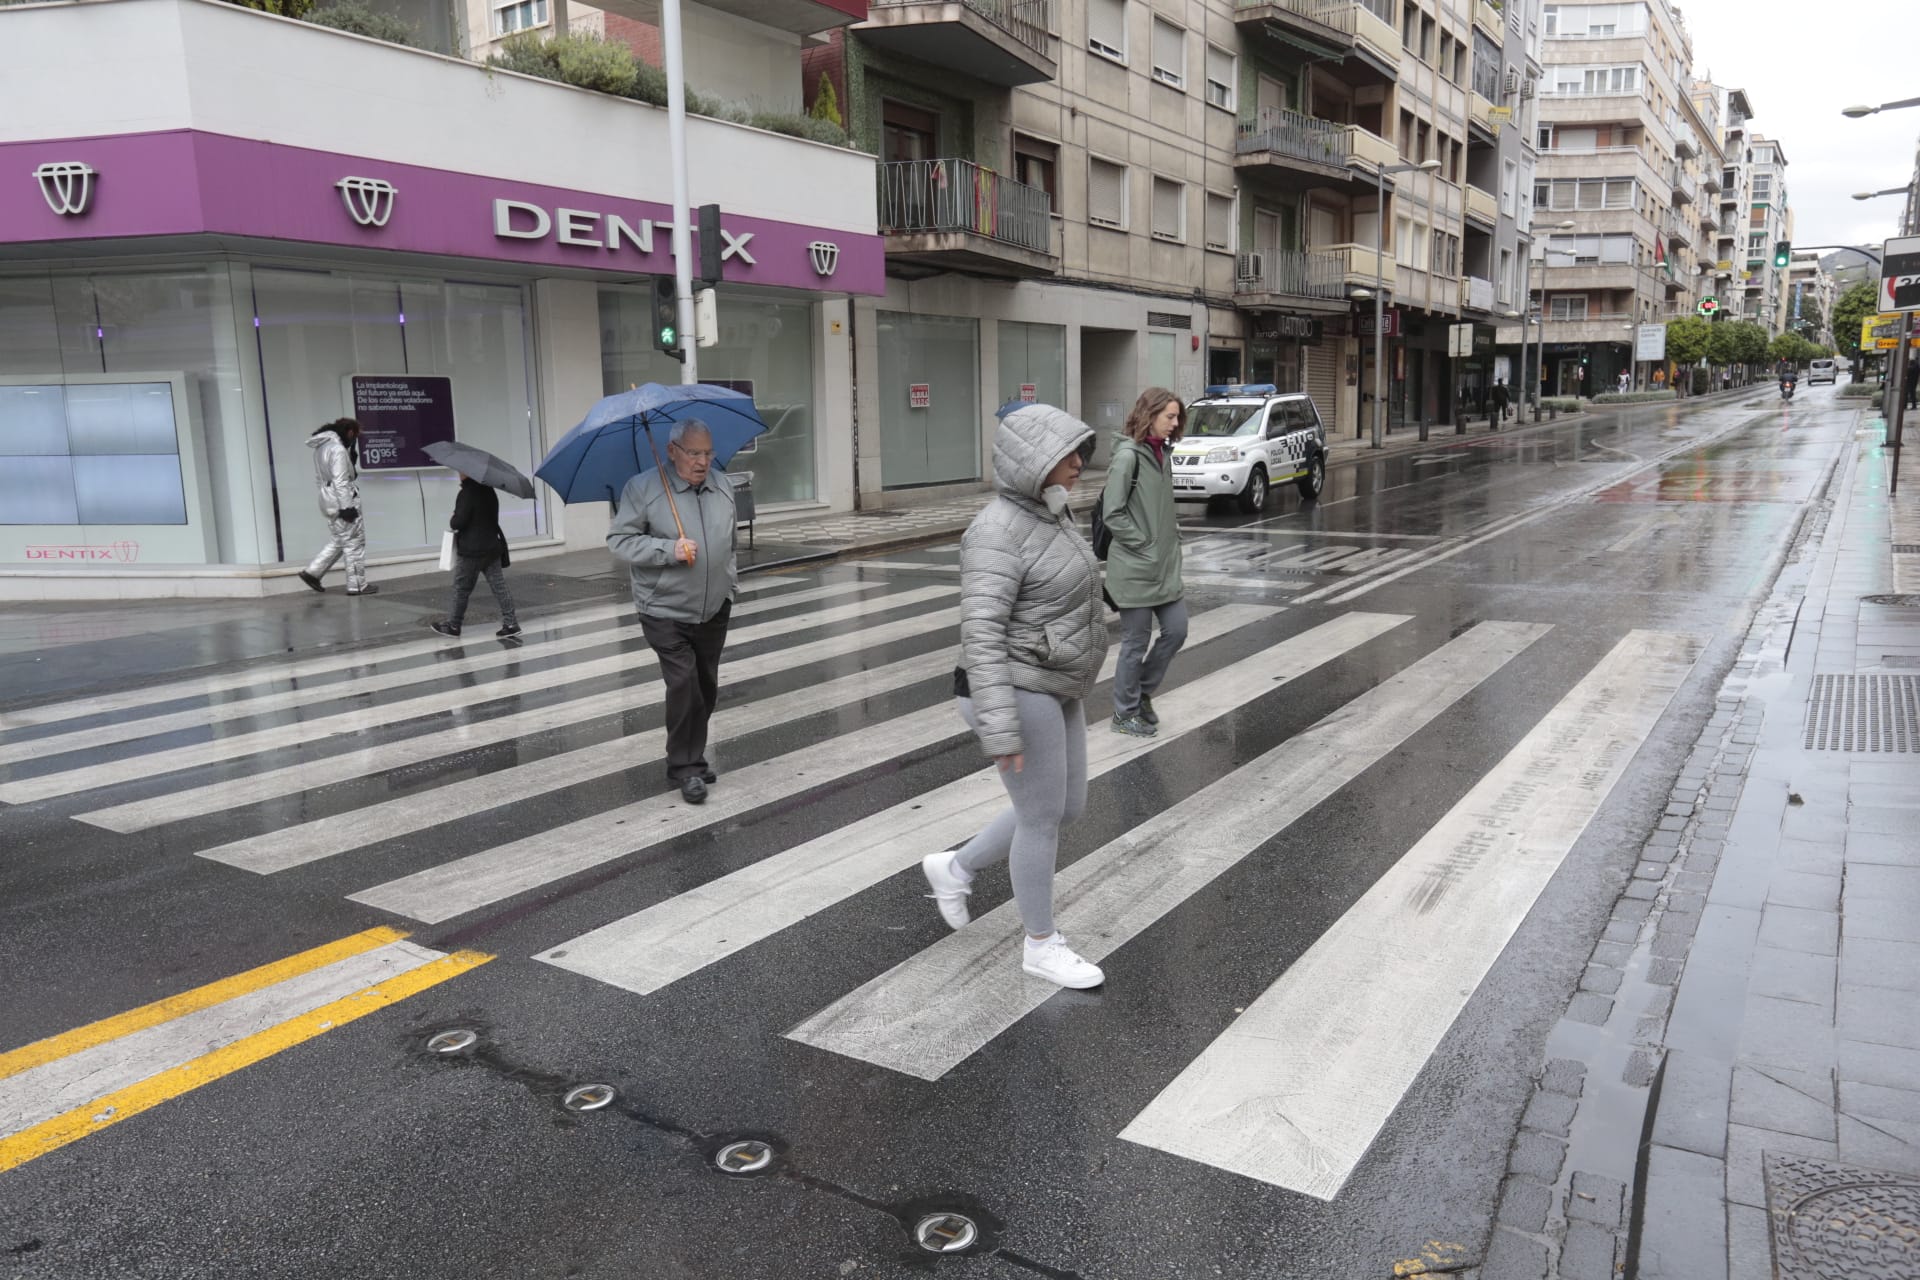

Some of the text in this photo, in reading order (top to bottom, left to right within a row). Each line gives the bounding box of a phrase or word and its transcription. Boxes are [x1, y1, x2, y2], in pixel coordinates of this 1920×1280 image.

[494, 199, 757, 264] DENTX
[1281, 315, 1313, 337] TATTOO
[26, 550, 112, 559] DENTIX
